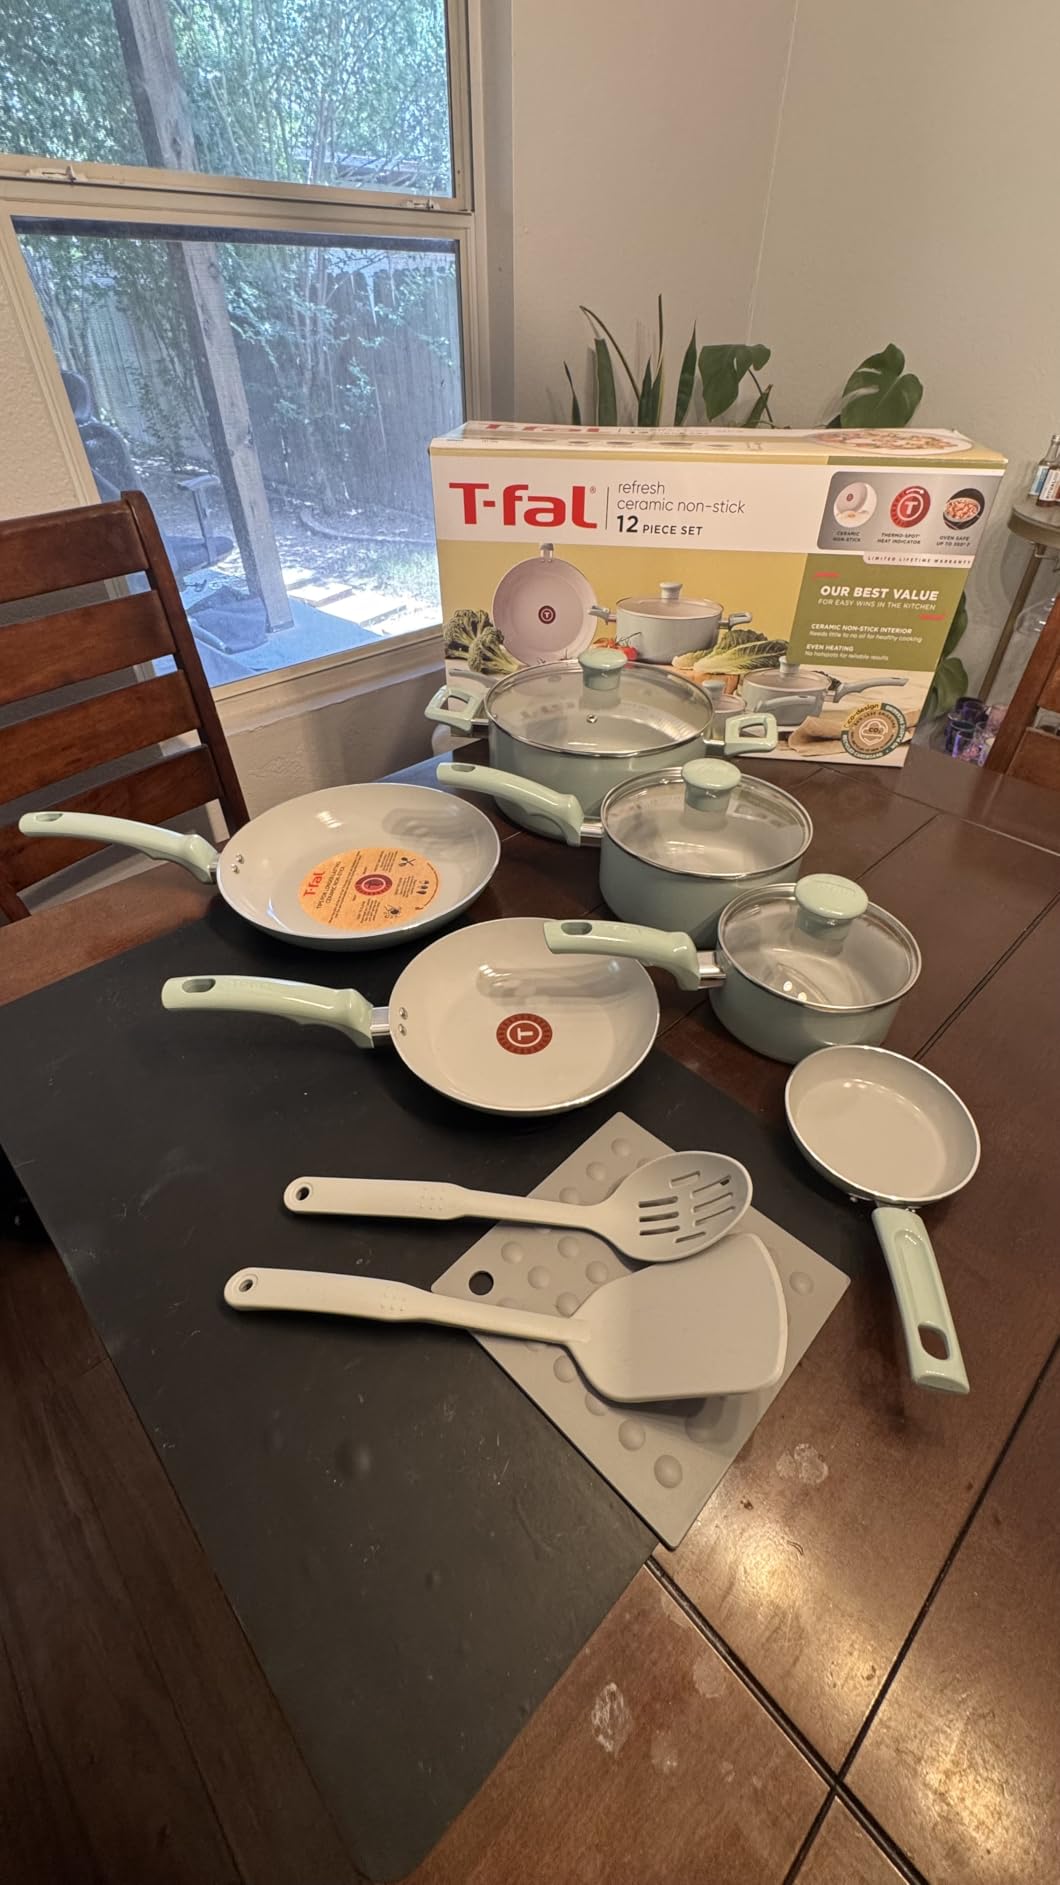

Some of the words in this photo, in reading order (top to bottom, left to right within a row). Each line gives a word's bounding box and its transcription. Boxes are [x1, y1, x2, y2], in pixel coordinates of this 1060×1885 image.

[618, 480, 665, 496] refresh
[617, 497, 674, 512] ceramic
[678, 499, 746, 515] non-stick
[616, 515, 639, 533] 12
[642, 524, 677, 535] PIECE
[681, 525, 703, 536] SET
[820, 585, 850, 596] OUR
[853, 587, 889, 599] BEST
[893, 589, 939, 601] VALUE
[887, 601, 902, 609] THE
[903, 602, 937, 611] KITCHEN
[811, 623, 841, 631] CERAMIC
[876, 634, 898, 642] healthy
[899, 636, 923, 644] cooking
[825, 644, 854, 652] HEATING
[303, 871, 325, 897] T-fal
